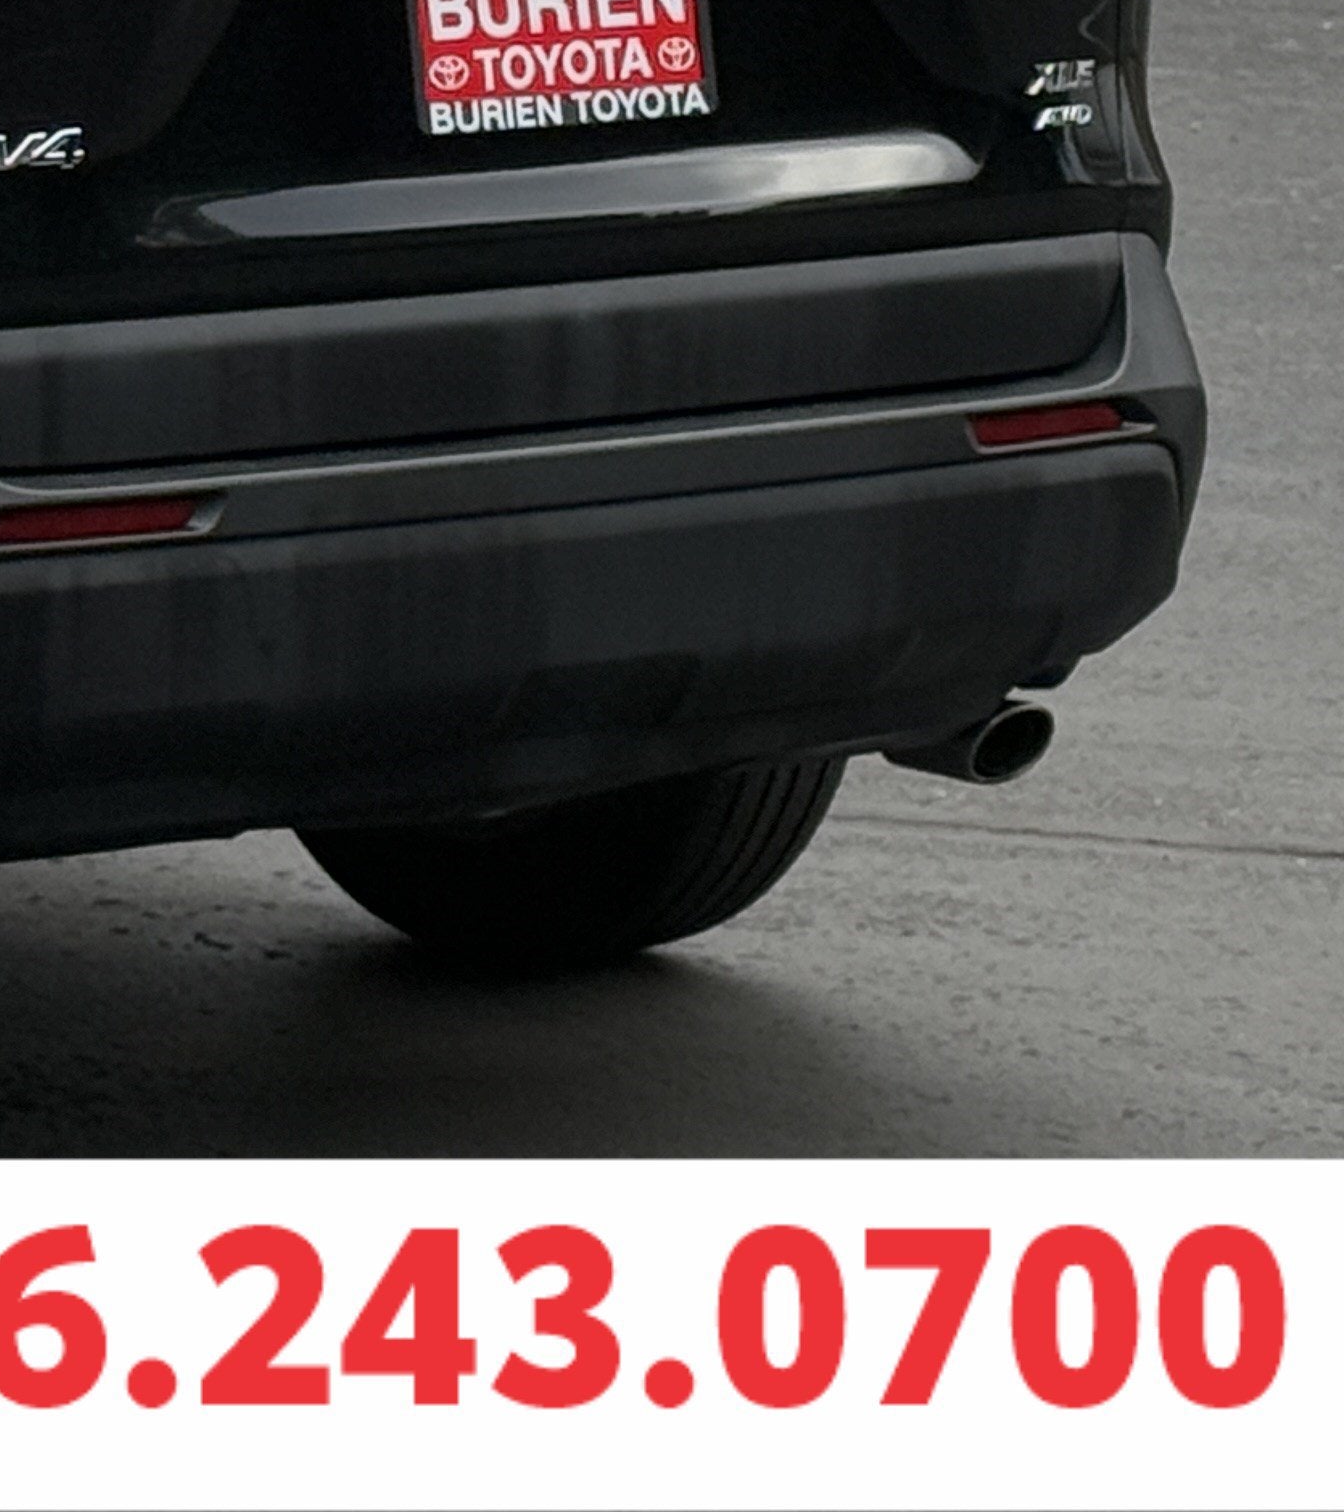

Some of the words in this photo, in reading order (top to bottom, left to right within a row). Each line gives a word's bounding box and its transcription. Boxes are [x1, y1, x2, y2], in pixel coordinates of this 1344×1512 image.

[473, 37, 654, 92] TOYOTA
[430, 93, 562, 135] BURIEN
[569, 83, 711, 124] TOYOTA
